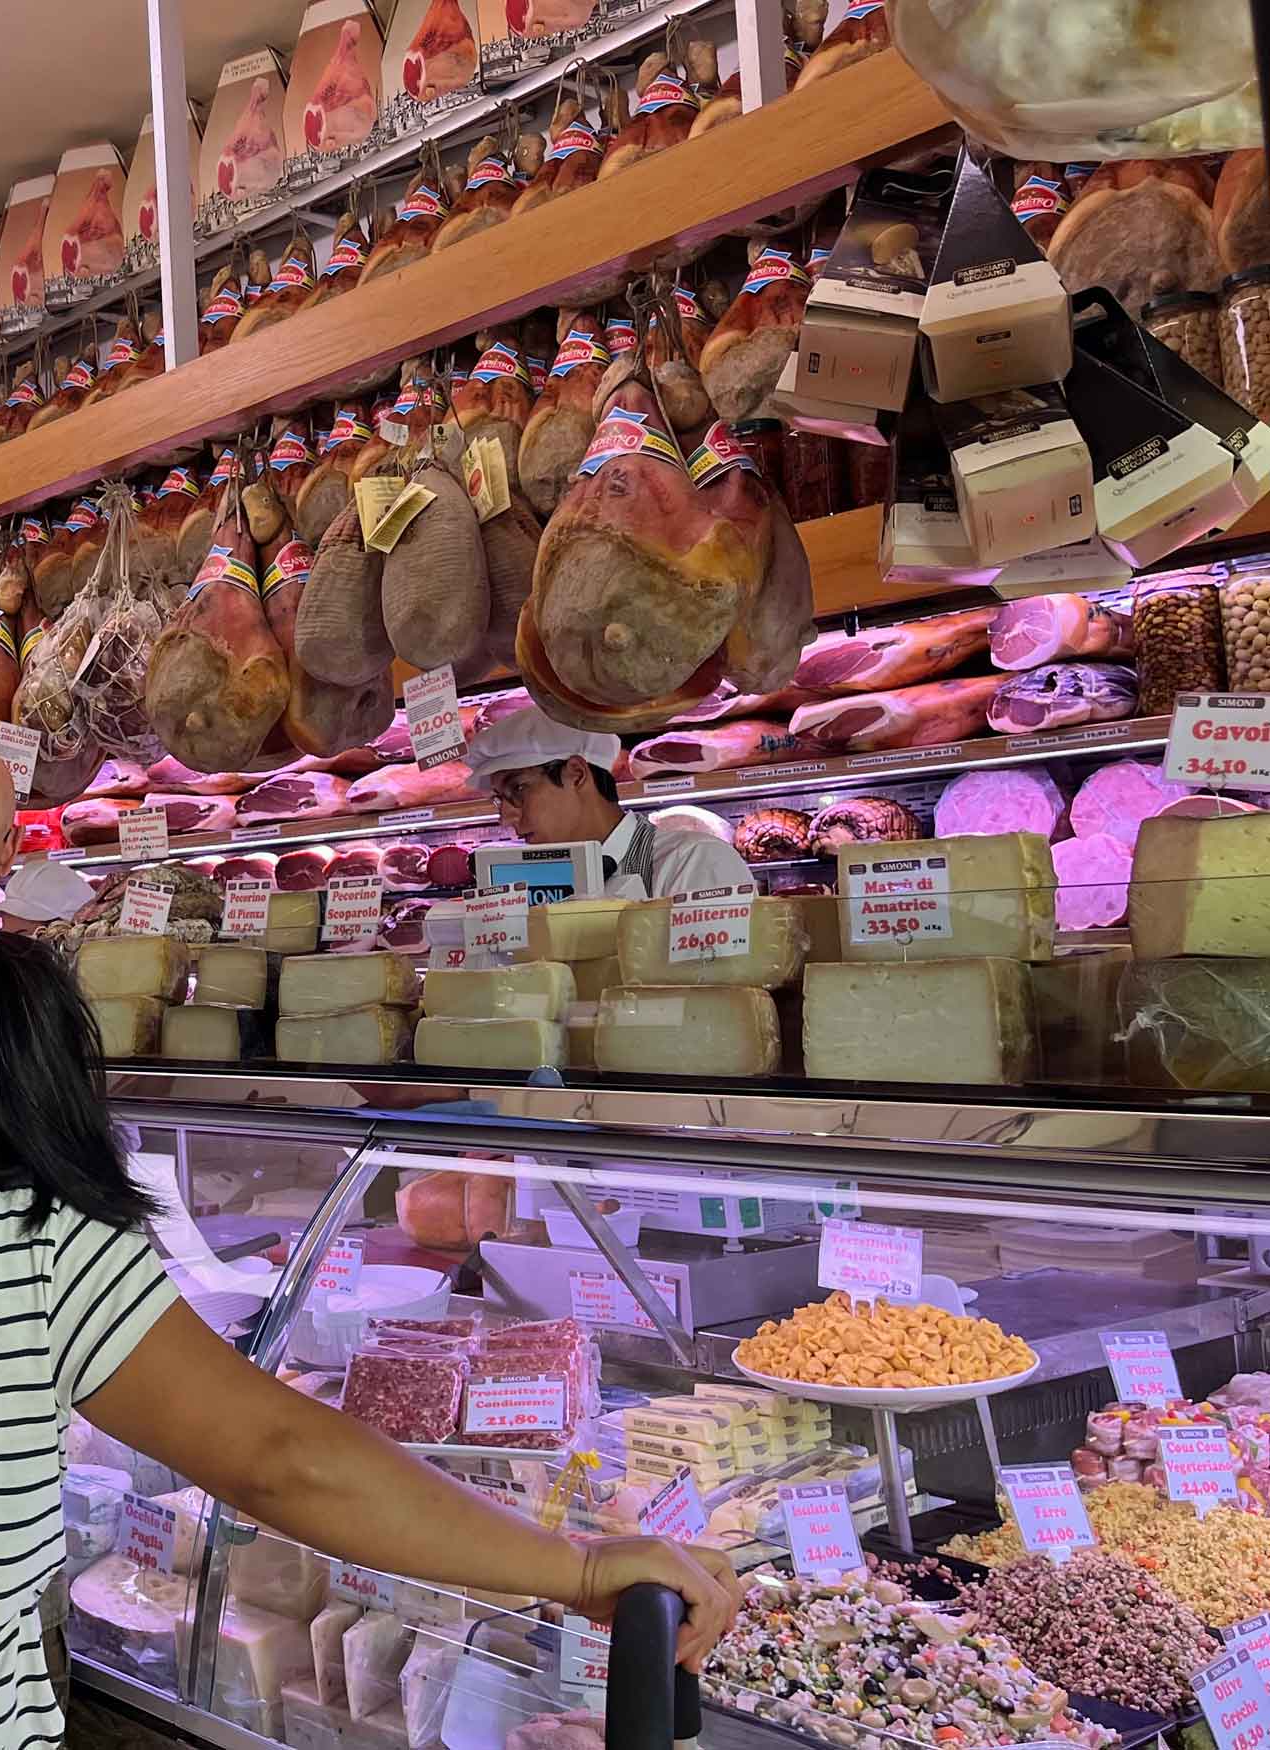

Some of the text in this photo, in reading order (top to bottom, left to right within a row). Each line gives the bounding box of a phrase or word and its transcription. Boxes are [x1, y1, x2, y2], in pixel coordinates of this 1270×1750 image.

[1218, 698, 1255, 707] SIMONI
[426, 747, 459, 767] SIMONI
[522, 848, 570, 860] BIZERBA
[881, 862, 912, 872] SIMONI
[917, 878, 933, 890] di
[230, 892, 266, 904] Pecorino
[332, 890, 377, 902] Pecorino
[699, 889, 726, 898] SIMONI
[861, 899, 937, 914] Amatrice
[237, 909, 265, 919] Pienza
[328, 907, 378, 921] Scoparolo
[672, 907, 749, 927] Moliterno
[470, 1387, 561, 1398] Prosciutto per
[475, 1399, 554, 1409] Condimento
[125, 1503, 160, 1529] Occhio
[132, 1526, 163, 1552] Puglia
[1214, 1676, 1243, 1702] Olive
[1221, 1700, 1259, 1731] Greche
